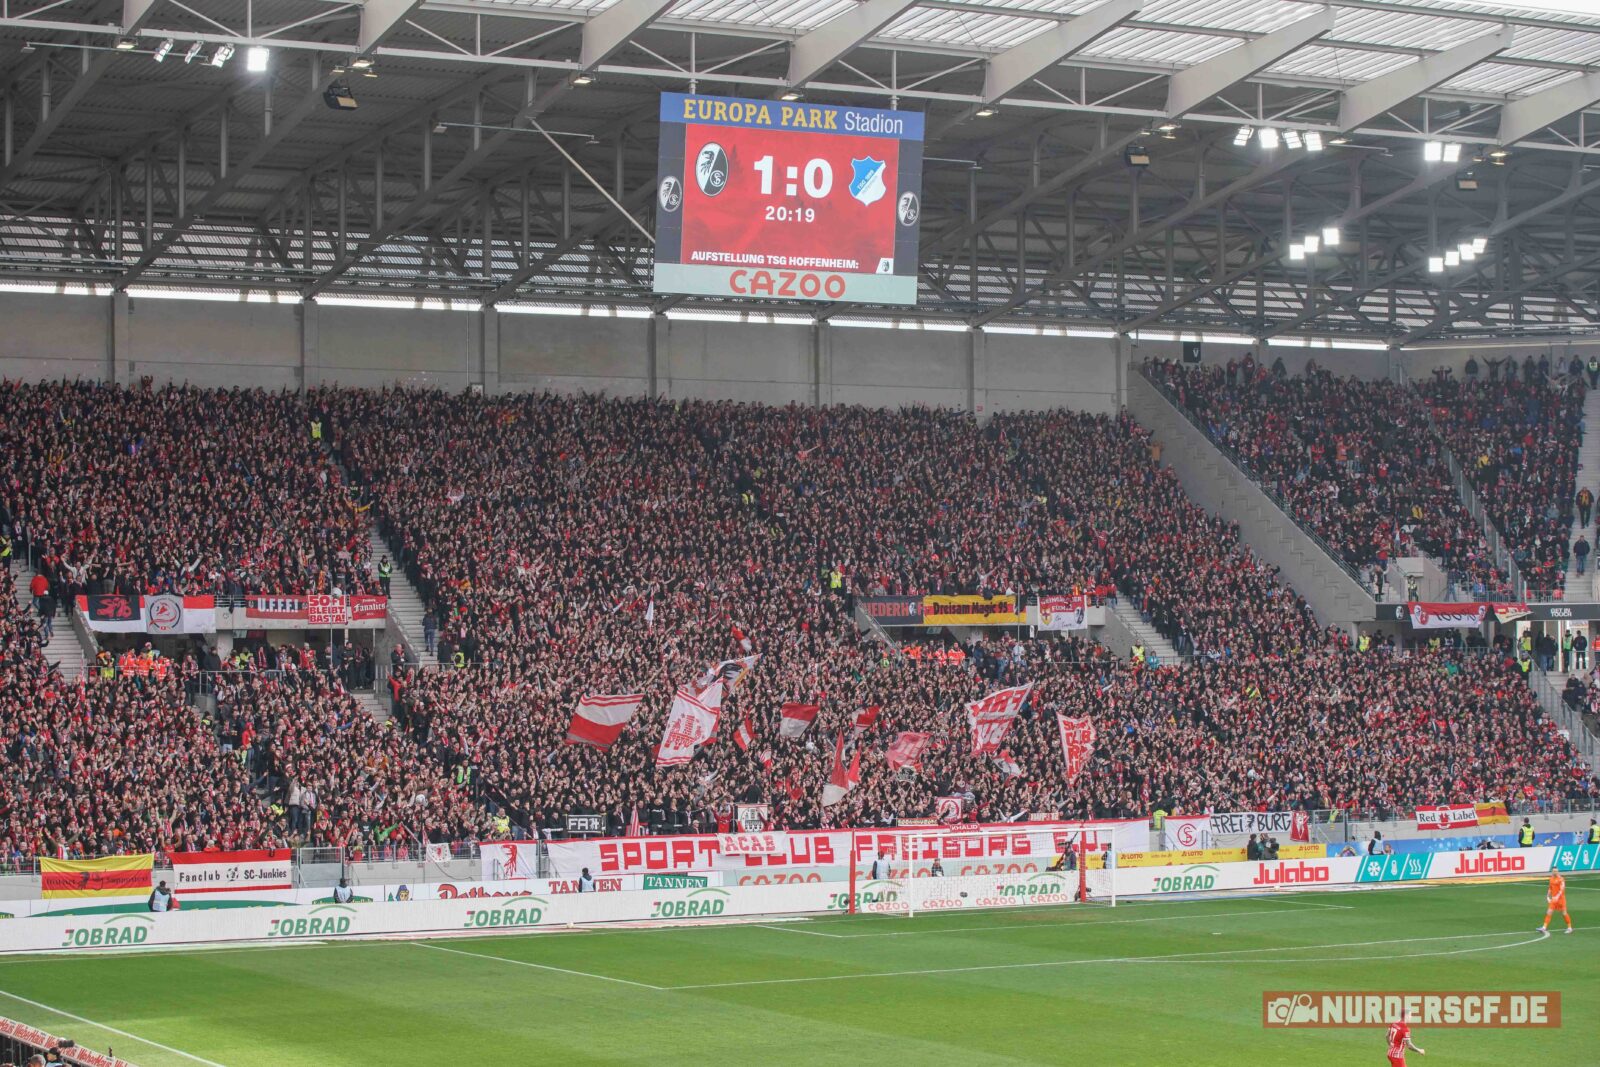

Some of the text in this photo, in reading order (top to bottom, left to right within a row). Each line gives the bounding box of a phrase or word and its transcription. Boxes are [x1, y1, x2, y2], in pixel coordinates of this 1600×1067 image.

[683, 98, 903, 134] EUROPA PARK Stadion
[753, 155, 833, 199] 1:0
[765, 205, 815, 222] 20:19
[691, 250, 859, 269] AUFSTELLUNG TSG HOFFENHEIM:
[729, 269, 846, 299] CAZOO
[933, 602, 970, 615] Dreisam
[998, 601, 1008, 613] 95
[1211, 812, 1292, 833] FREI BURG
[1419, 811, 1476, 823] Red Label
[599, 839, 719, 871] SPORT
[856, 833, 1031, 861] FREIBURG
[724, 835, 777, 852] ACAB
[1254, 861, 1329, 884] Julabo
[1455, 852, 1525, 874] Julabo
[178, 869, 287, 882] Fanclub SC-Junkies
[646, 877, 705, 889] TANNEN
[1152, 875, 1215, 892] JOBRAD
[465, 908, 543, 927] JOBRAD
[651, 899, 724, 917] JOBRAD
[268, 916, 350, 936] JOBRAD
[61, 926, 148, 946] JOBRAD
